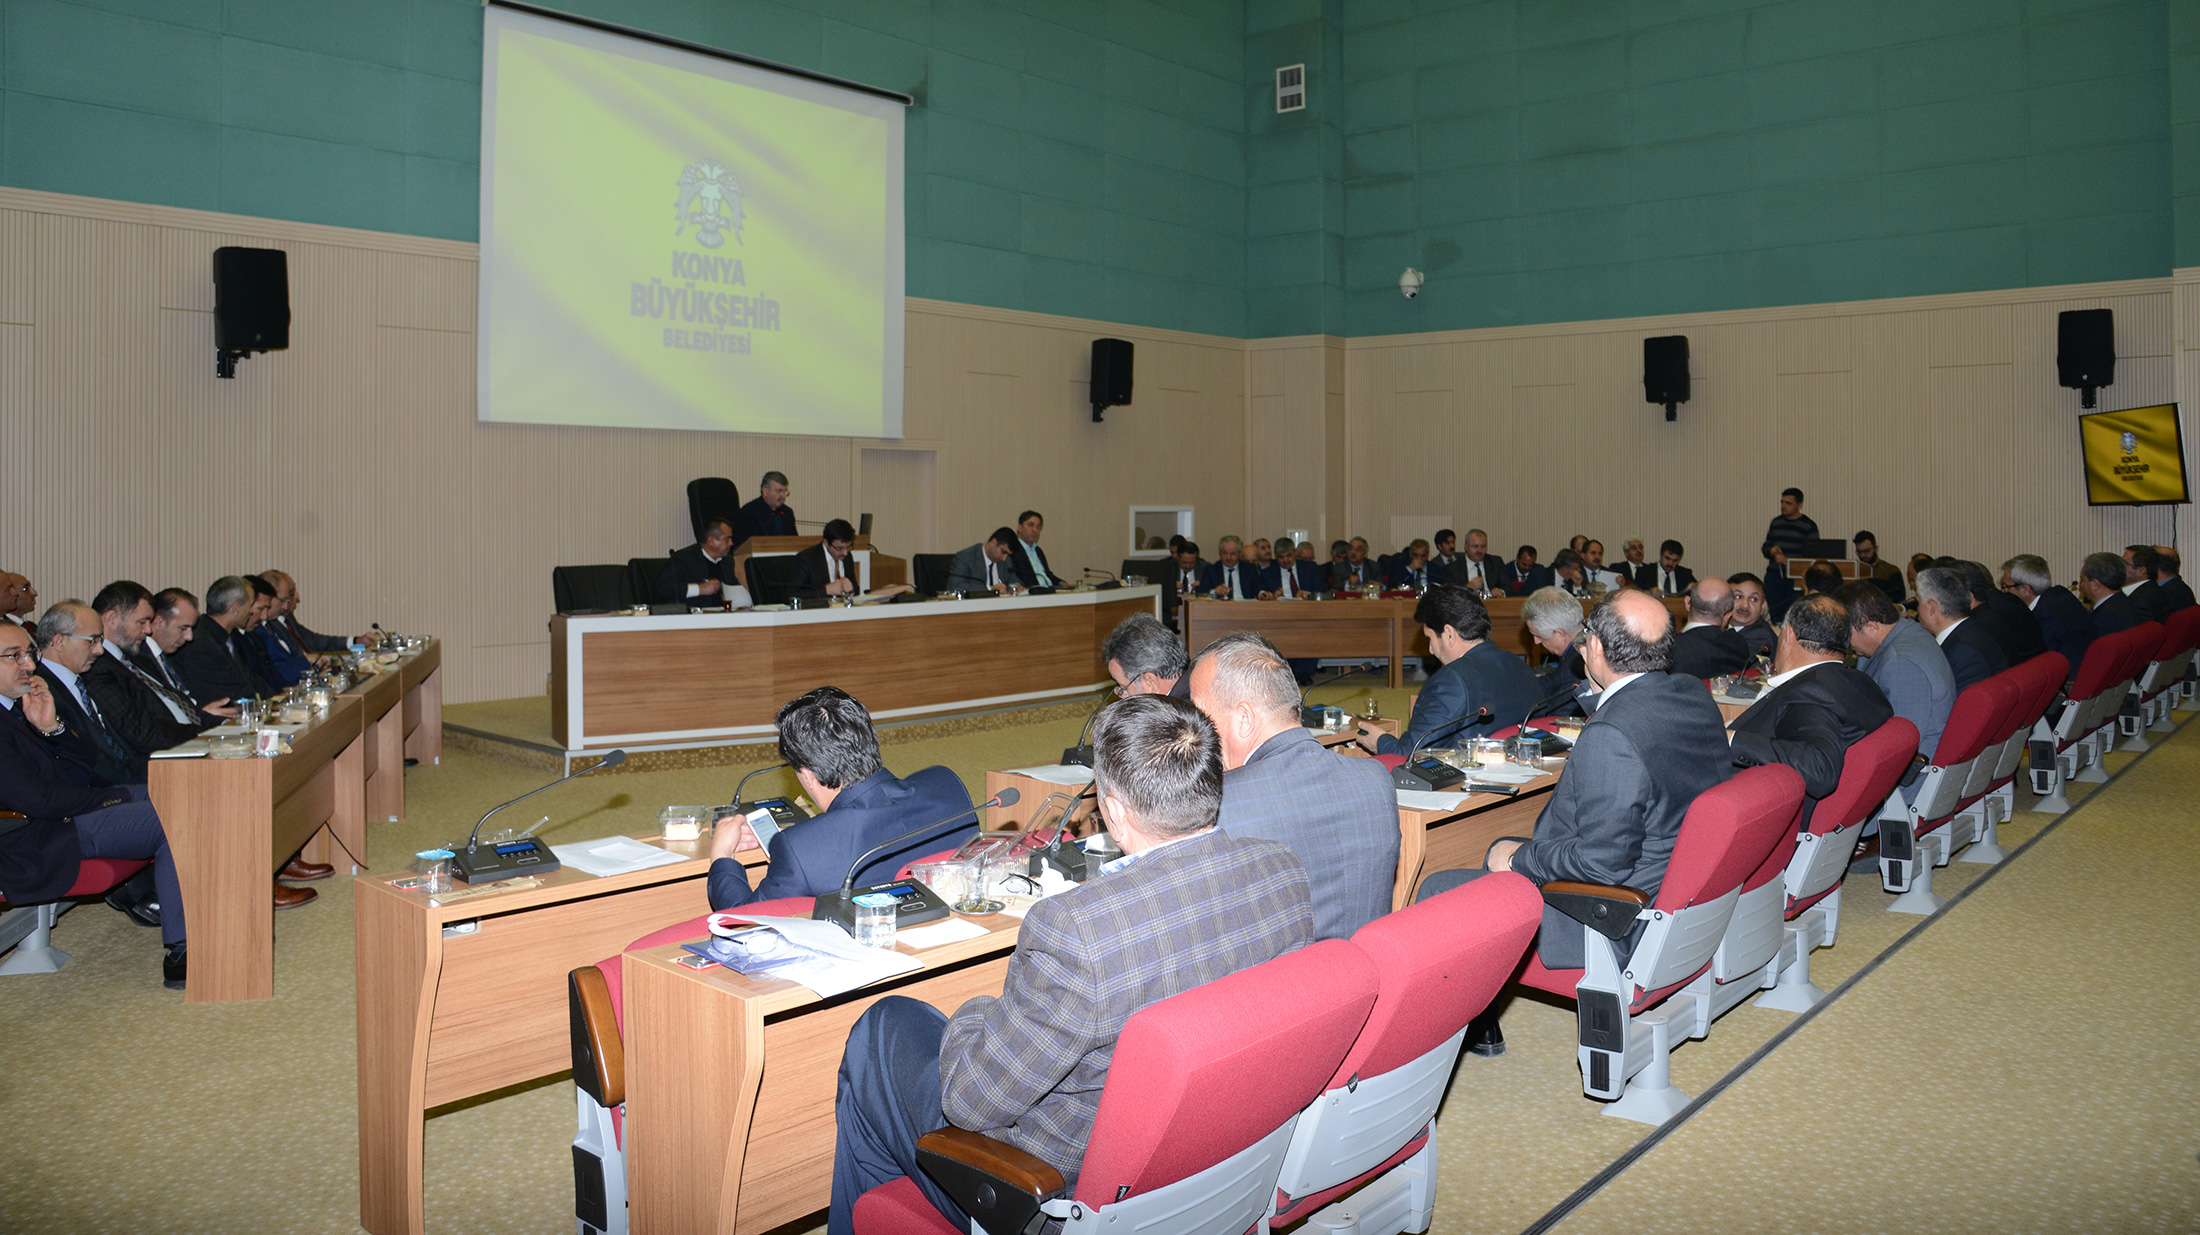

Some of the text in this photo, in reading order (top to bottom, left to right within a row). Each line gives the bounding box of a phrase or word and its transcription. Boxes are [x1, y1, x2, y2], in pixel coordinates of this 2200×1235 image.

[672, 250, 746, 287] KONYA
[631, 277, 780, 332] BÜYÜKŞEHİR
[663, 328, 751, 355] BELEDİYESİ
